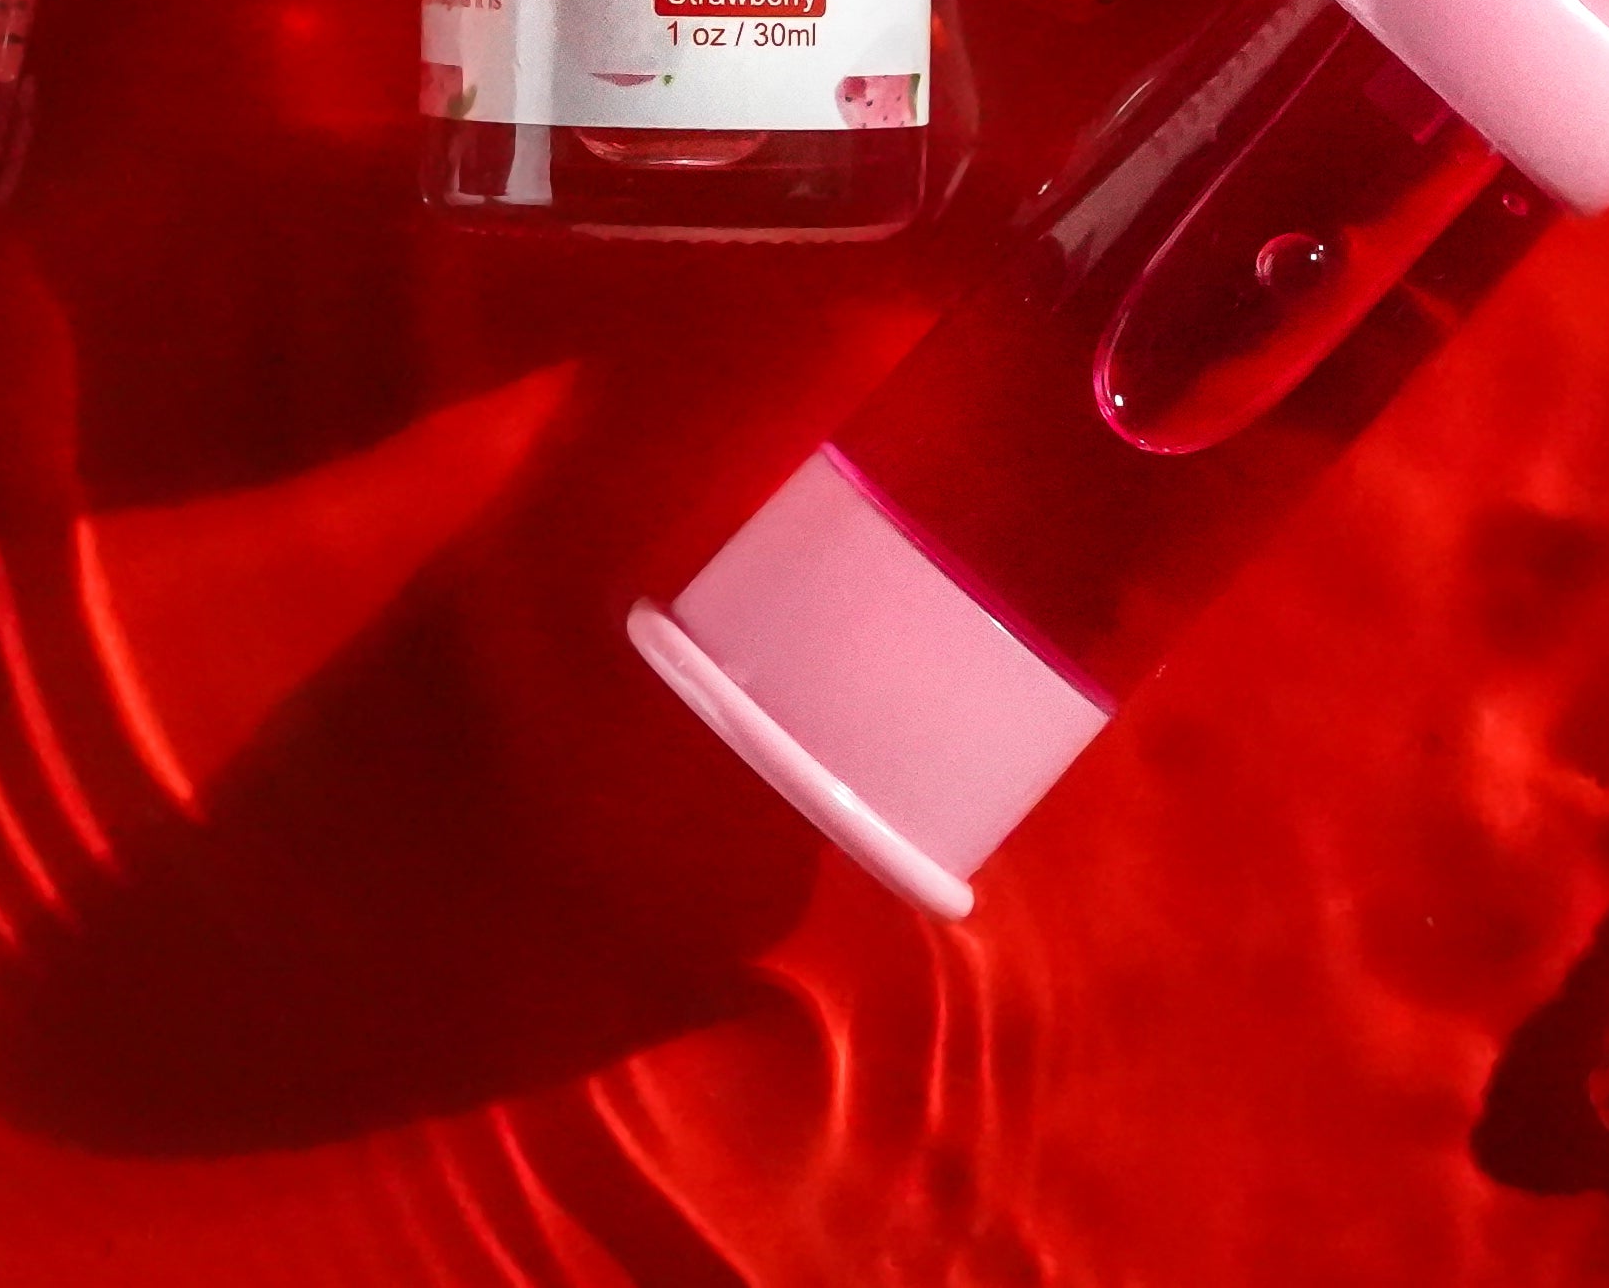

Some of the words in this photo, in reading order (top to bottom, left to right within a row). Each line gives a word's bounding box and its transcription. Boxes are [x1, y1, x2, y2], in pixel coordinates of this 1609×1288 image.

[666, 19, 679, 47] 1
[692, 27, 727, 47] oz
[735, 20, 745, 47] /
[753, 21, 817, 47] 30ml
